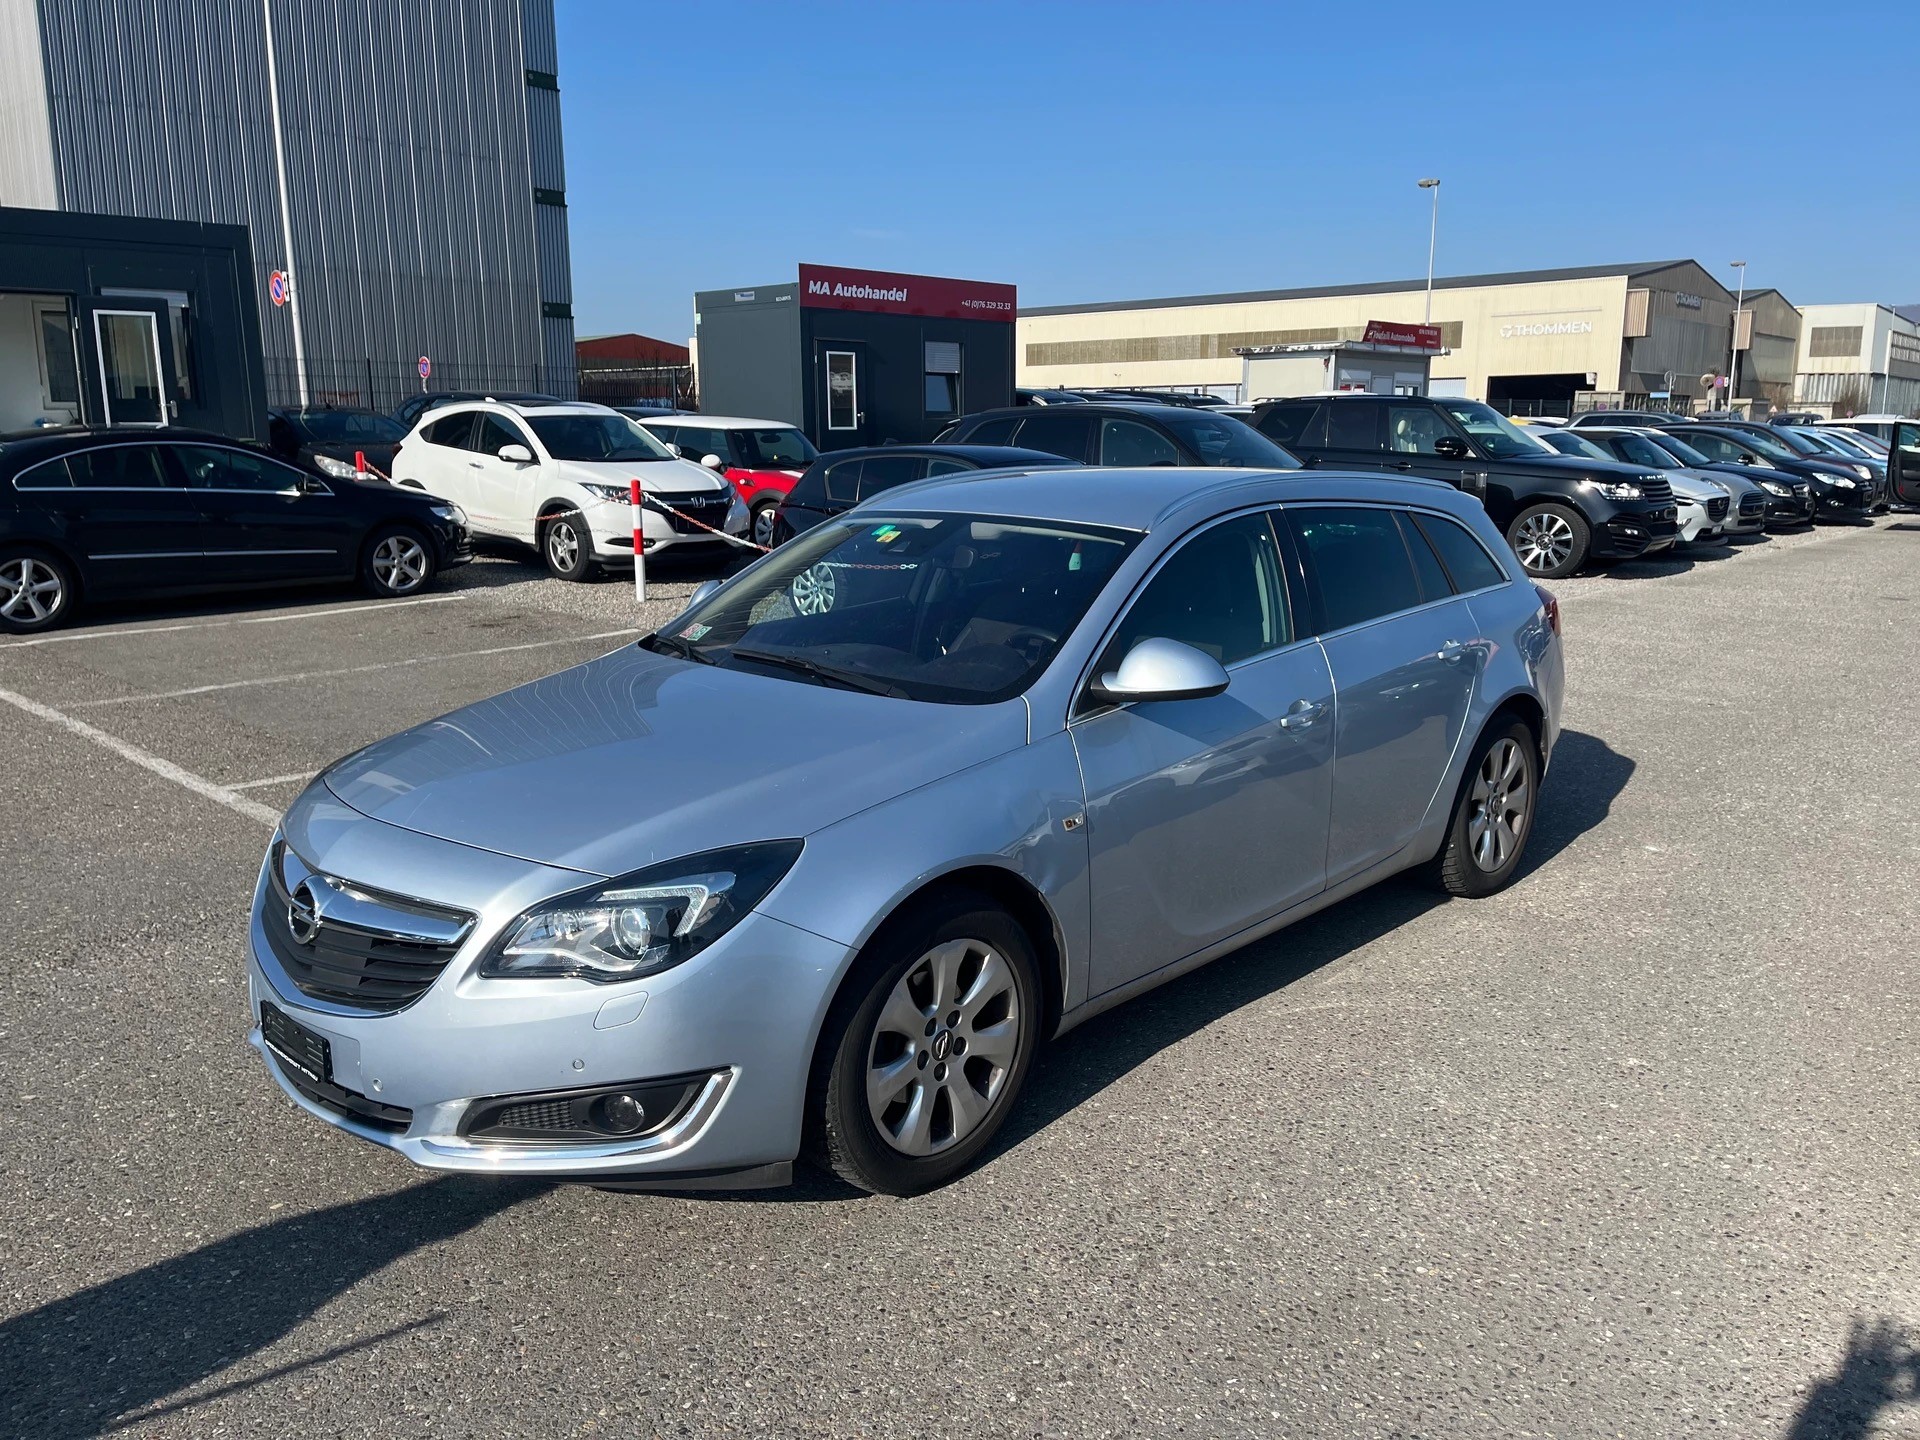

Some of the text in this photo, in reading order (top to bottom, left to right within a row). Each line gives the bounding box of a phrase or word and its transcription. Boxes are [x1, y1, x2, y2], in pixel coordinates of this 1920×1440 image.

[808, 280, 908, 302] MA Autohandel
[961, 299, 971, 307] +41
[986, 301, 997, 309] 329
[997, 302, 1004, 310] 32
[1004, 302, 1011, 310] 33
[1515, 321, 1592, 337] THOMMEN
